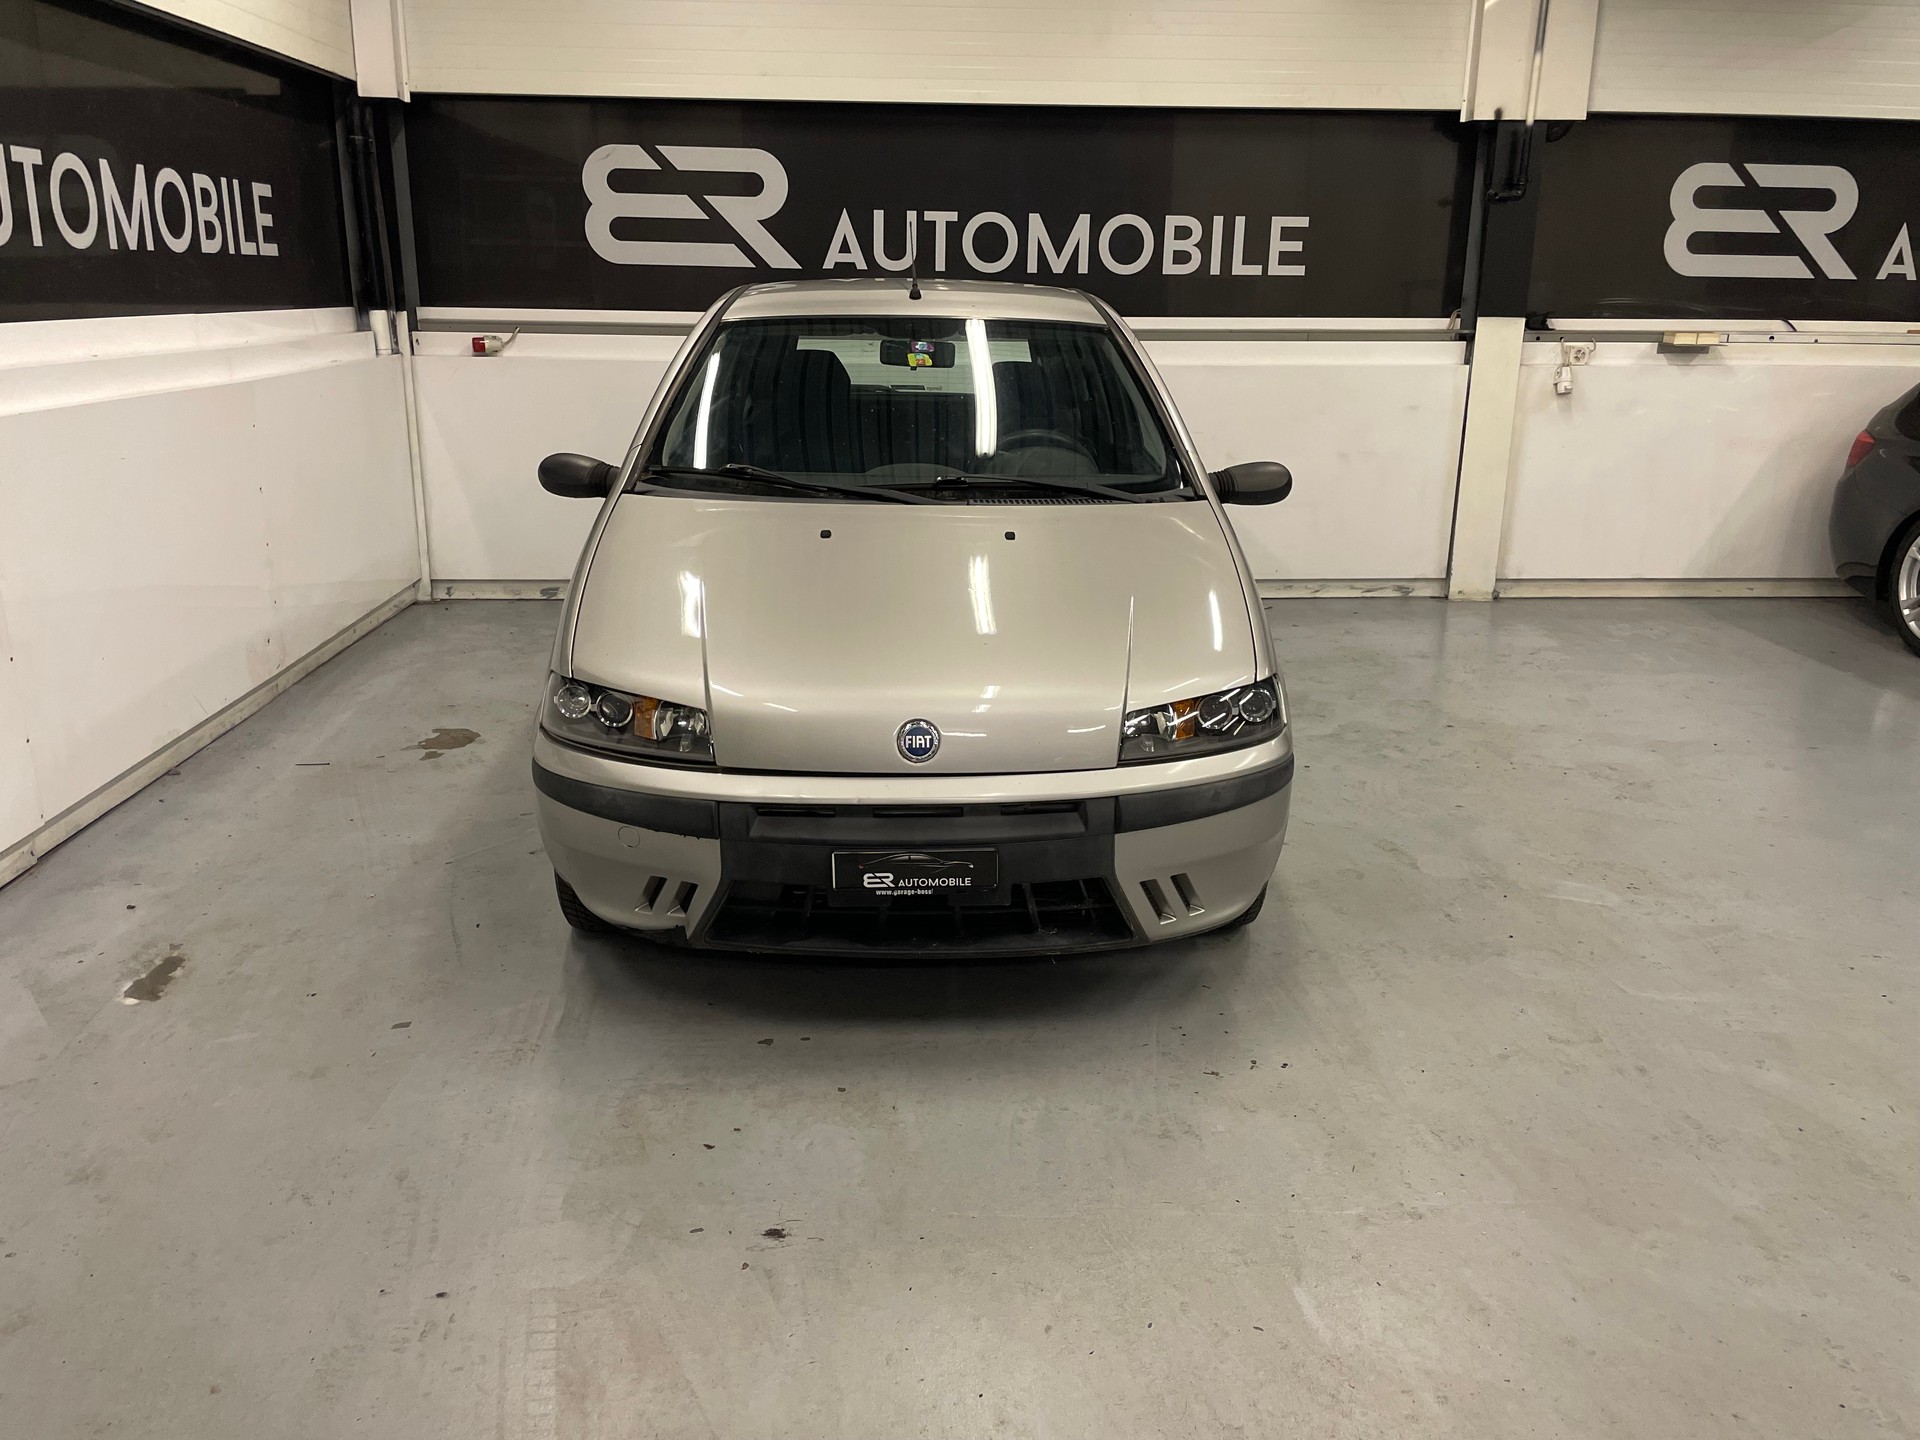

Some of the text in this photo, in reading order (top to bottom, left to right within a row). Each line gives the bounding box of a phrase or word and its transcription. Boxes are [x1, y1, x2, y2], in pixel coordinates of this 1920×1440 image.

[822, 207, 1310, 277] AUTOMOBILE
[905, 735, 932, 748] FIAT
[898, 877, 972, 887] AUTOMOBILE
